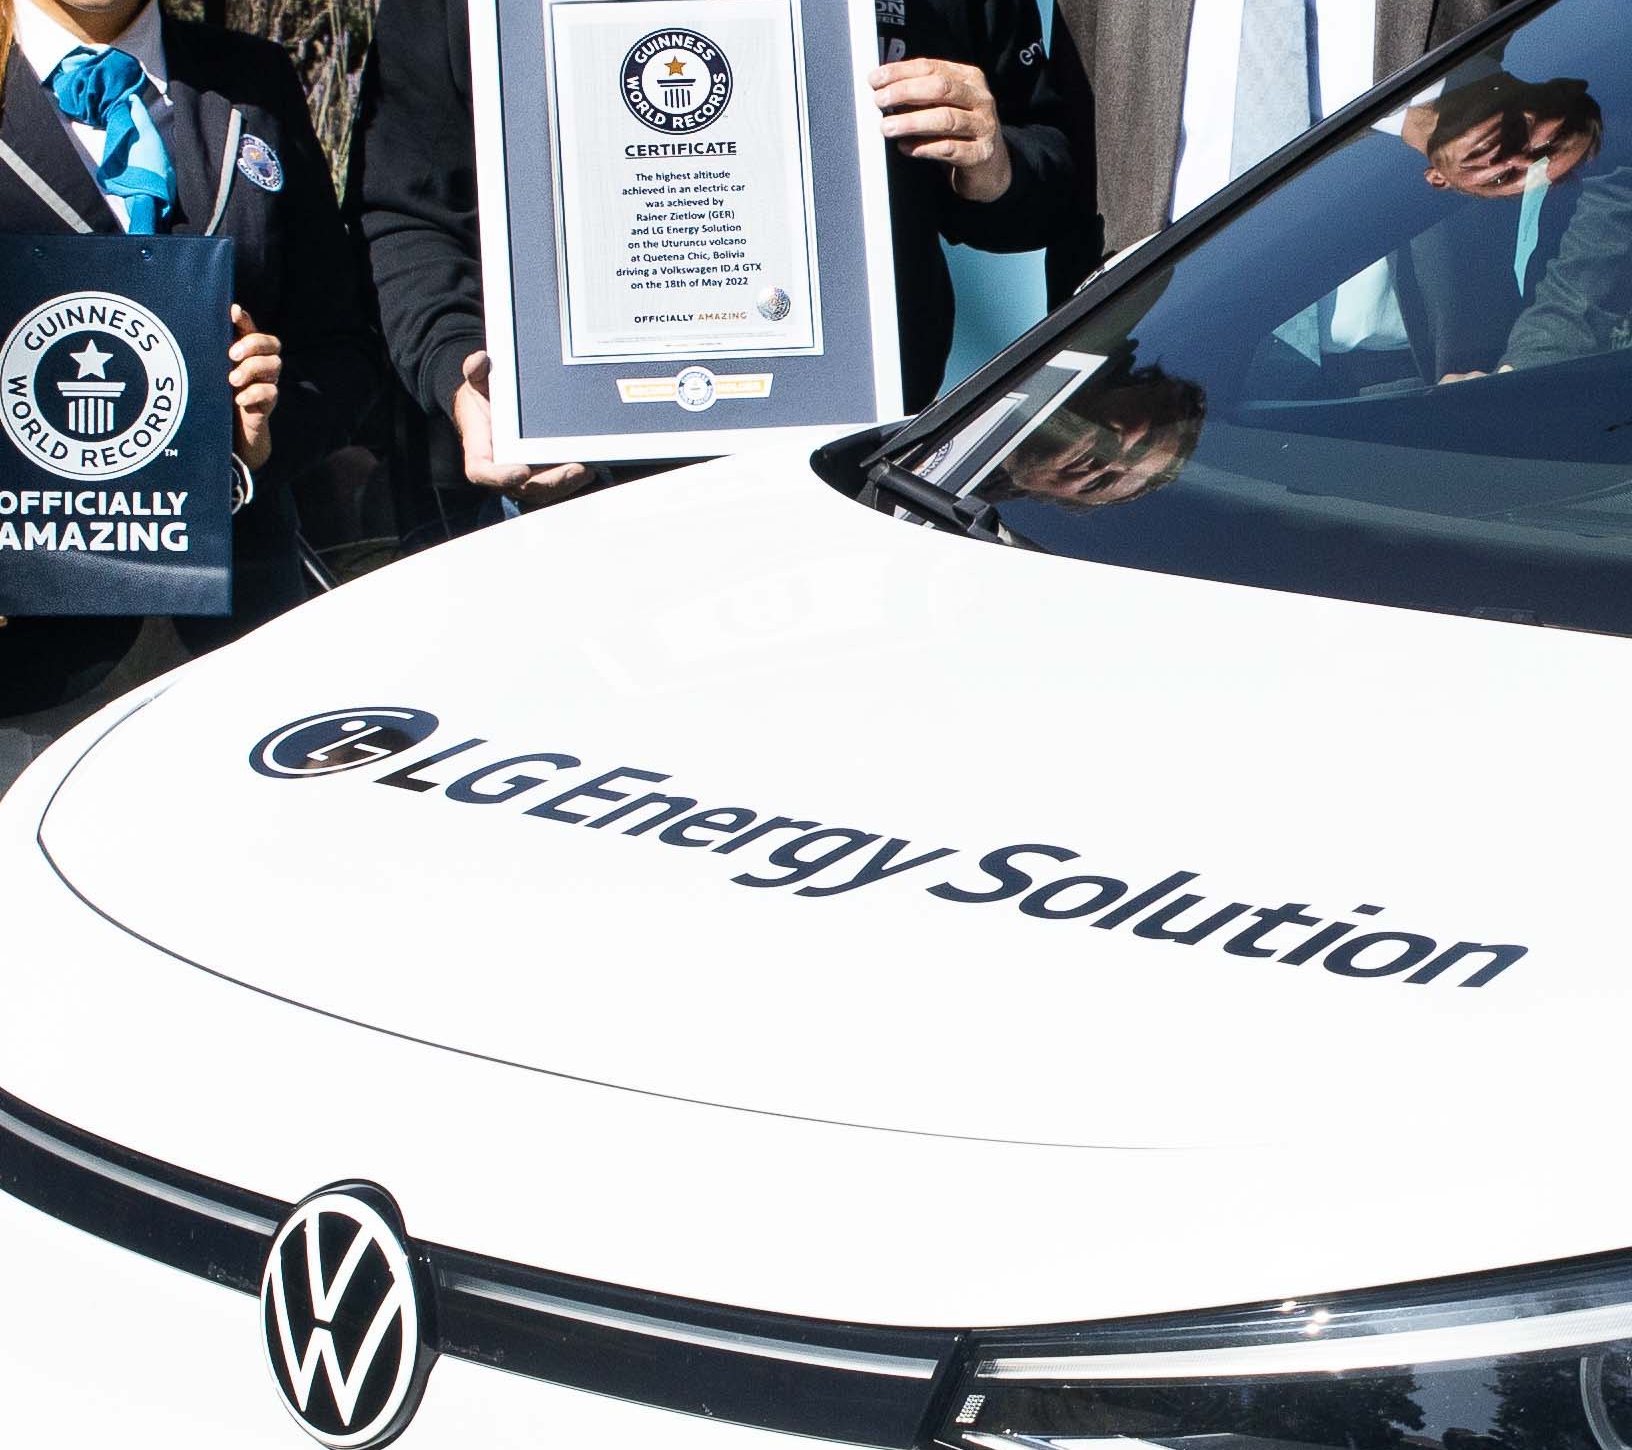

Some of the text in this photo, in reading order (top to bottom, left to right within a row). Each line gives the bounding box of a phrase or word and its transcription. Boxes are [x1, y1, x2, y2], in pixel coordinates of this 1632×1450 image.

[634, 35, 715, 64] GUINNESS
[627, 73, 726, 129] WORLD RECORDS
[625, 142, 736, 156] CERTIFICATE
[636, 170, 730, 182] The highest altitude
[622, 186, 664, 195] achieved
[668, 185, 676, 193] in
[694, 184, 728, 193] electric
[667, 197, 709, 207] achieved
[712, 197, 723, 207] by
[670, 211, 705, 221] Zietlow
[709, 211, 735, 221] (GER)
[631, 227, 649, 235] and
[667, 226, 699, 235] Energy
[702, 224, 742, 233] Solution
[662, 239, 706, 247] Uturuncu
[709, 237, 746, 246] volcano
[644, 253, 684, 262] Quetena
[688, 251, 710, 261] Chic,
[713, 251, 744, 259] Bolivia
[616, 268, 649, 277] driving
[660, 265, 718, 275] Volkswagen
[721, 264, 739, 272] ID.4
[742, 263, 762, 271] GTX
[646, 280, 662, 289] the
[665, 279, 686, 289] 18th
[689, 279, 698, 287] of
[702, 278, 722, 287] May
[726, 277, 748, 285] 2022
[634, 312, 748, 324] OFFICIALLY AMAZING
[24, 305, 160, 354] GUINNESS
[7, 375, 68, 460] WORLD
[81, 375, 174, 469] RECORDS
[372, 738, 1530, 989] LG Energy Solution
